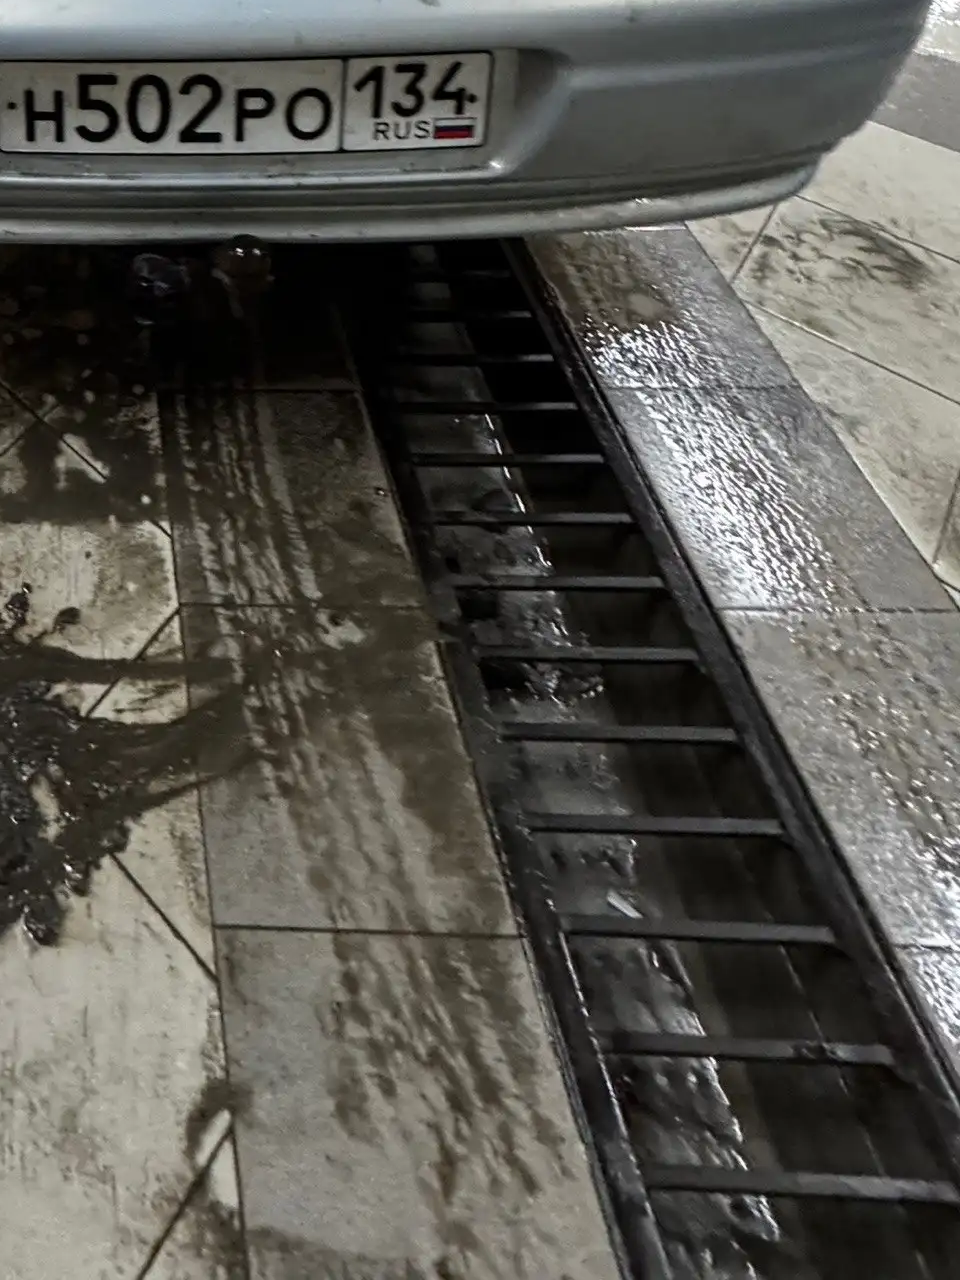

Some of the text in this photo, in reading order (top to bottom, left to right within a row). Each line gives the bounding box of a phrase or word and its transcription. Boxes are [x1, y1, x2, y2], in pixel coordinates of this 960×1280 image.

[23, 60, 469, 143] Н502РО 134
[372, 119, 431, 141] RUS
